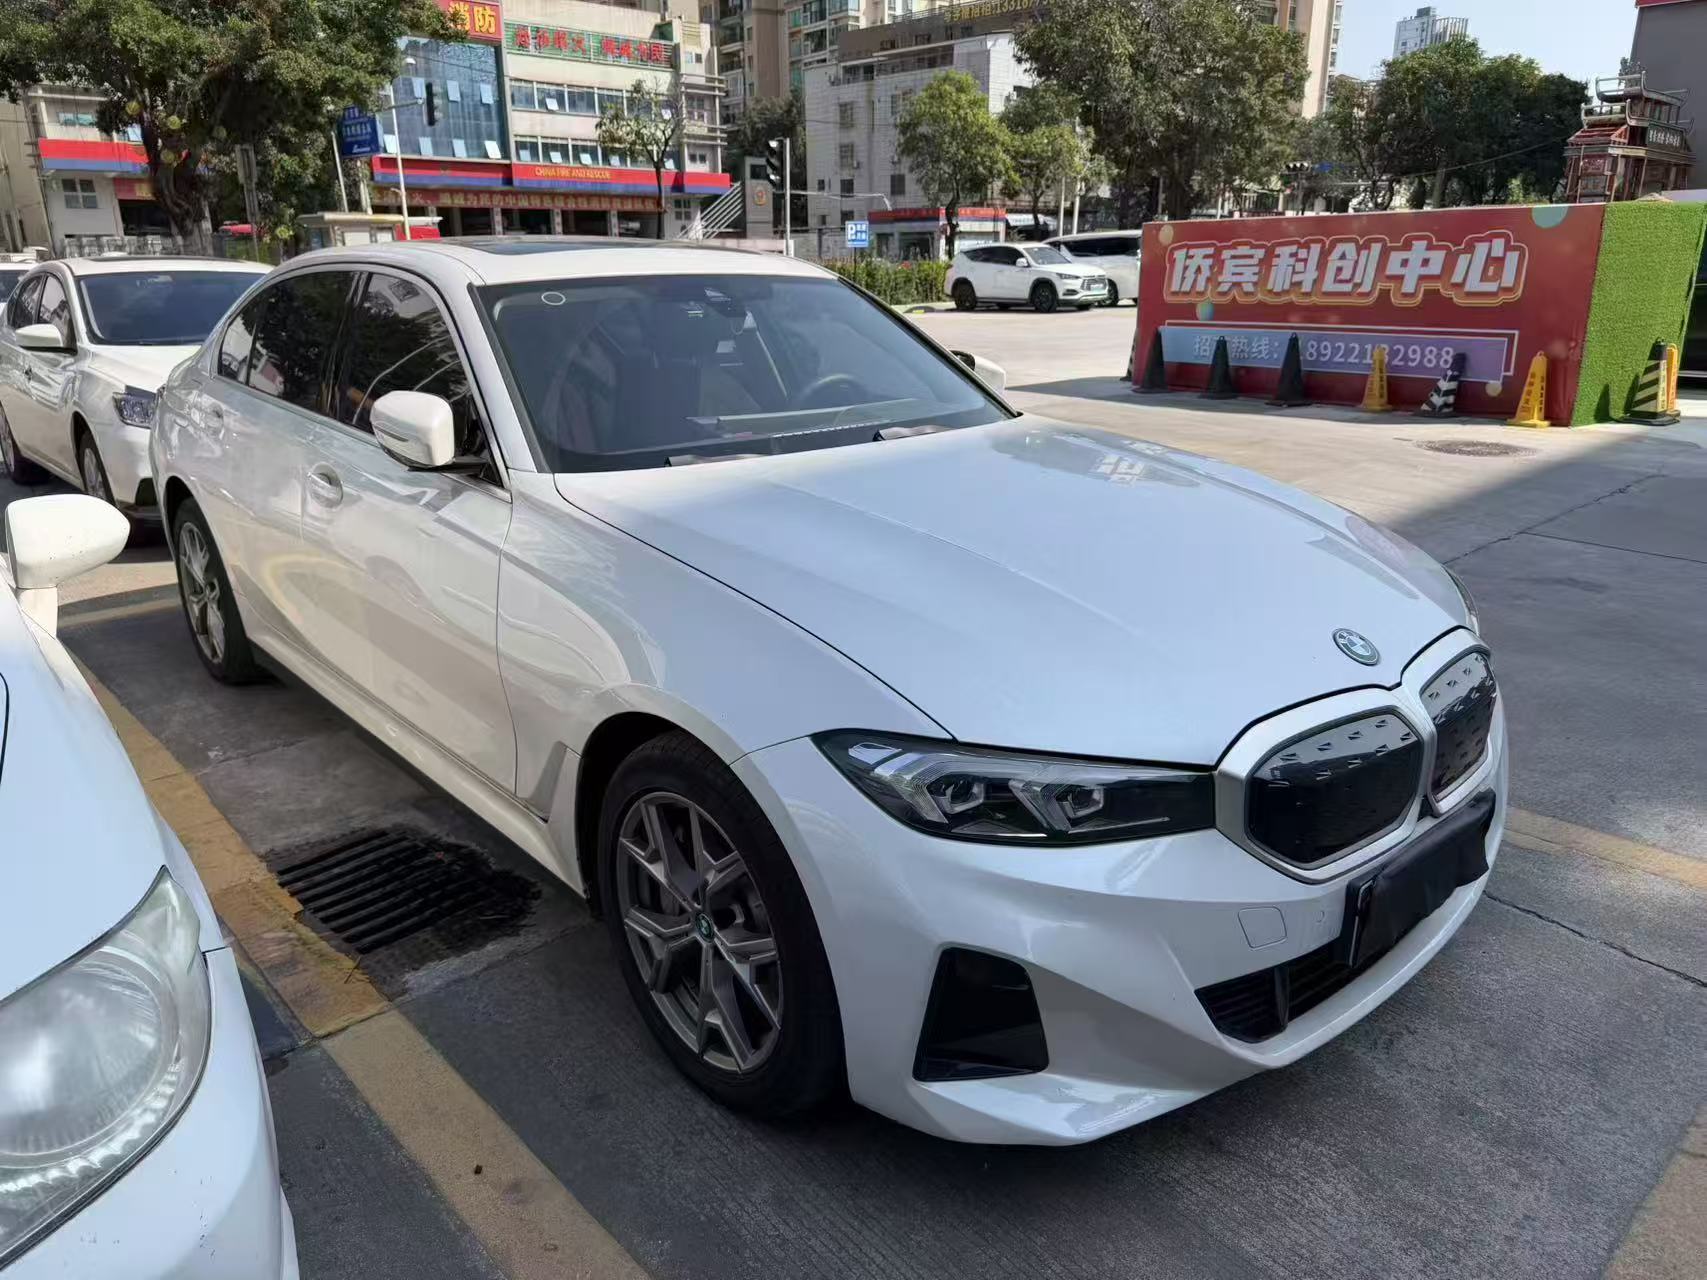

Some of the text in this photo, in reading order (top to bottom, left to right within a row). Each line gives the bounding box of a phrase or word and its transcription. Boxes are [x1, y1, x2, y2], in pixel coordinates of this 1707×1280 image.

[1170, 238, 1521, 293] 侨宾科创中心
[1193, 335, 1279, 360] 招热线：
